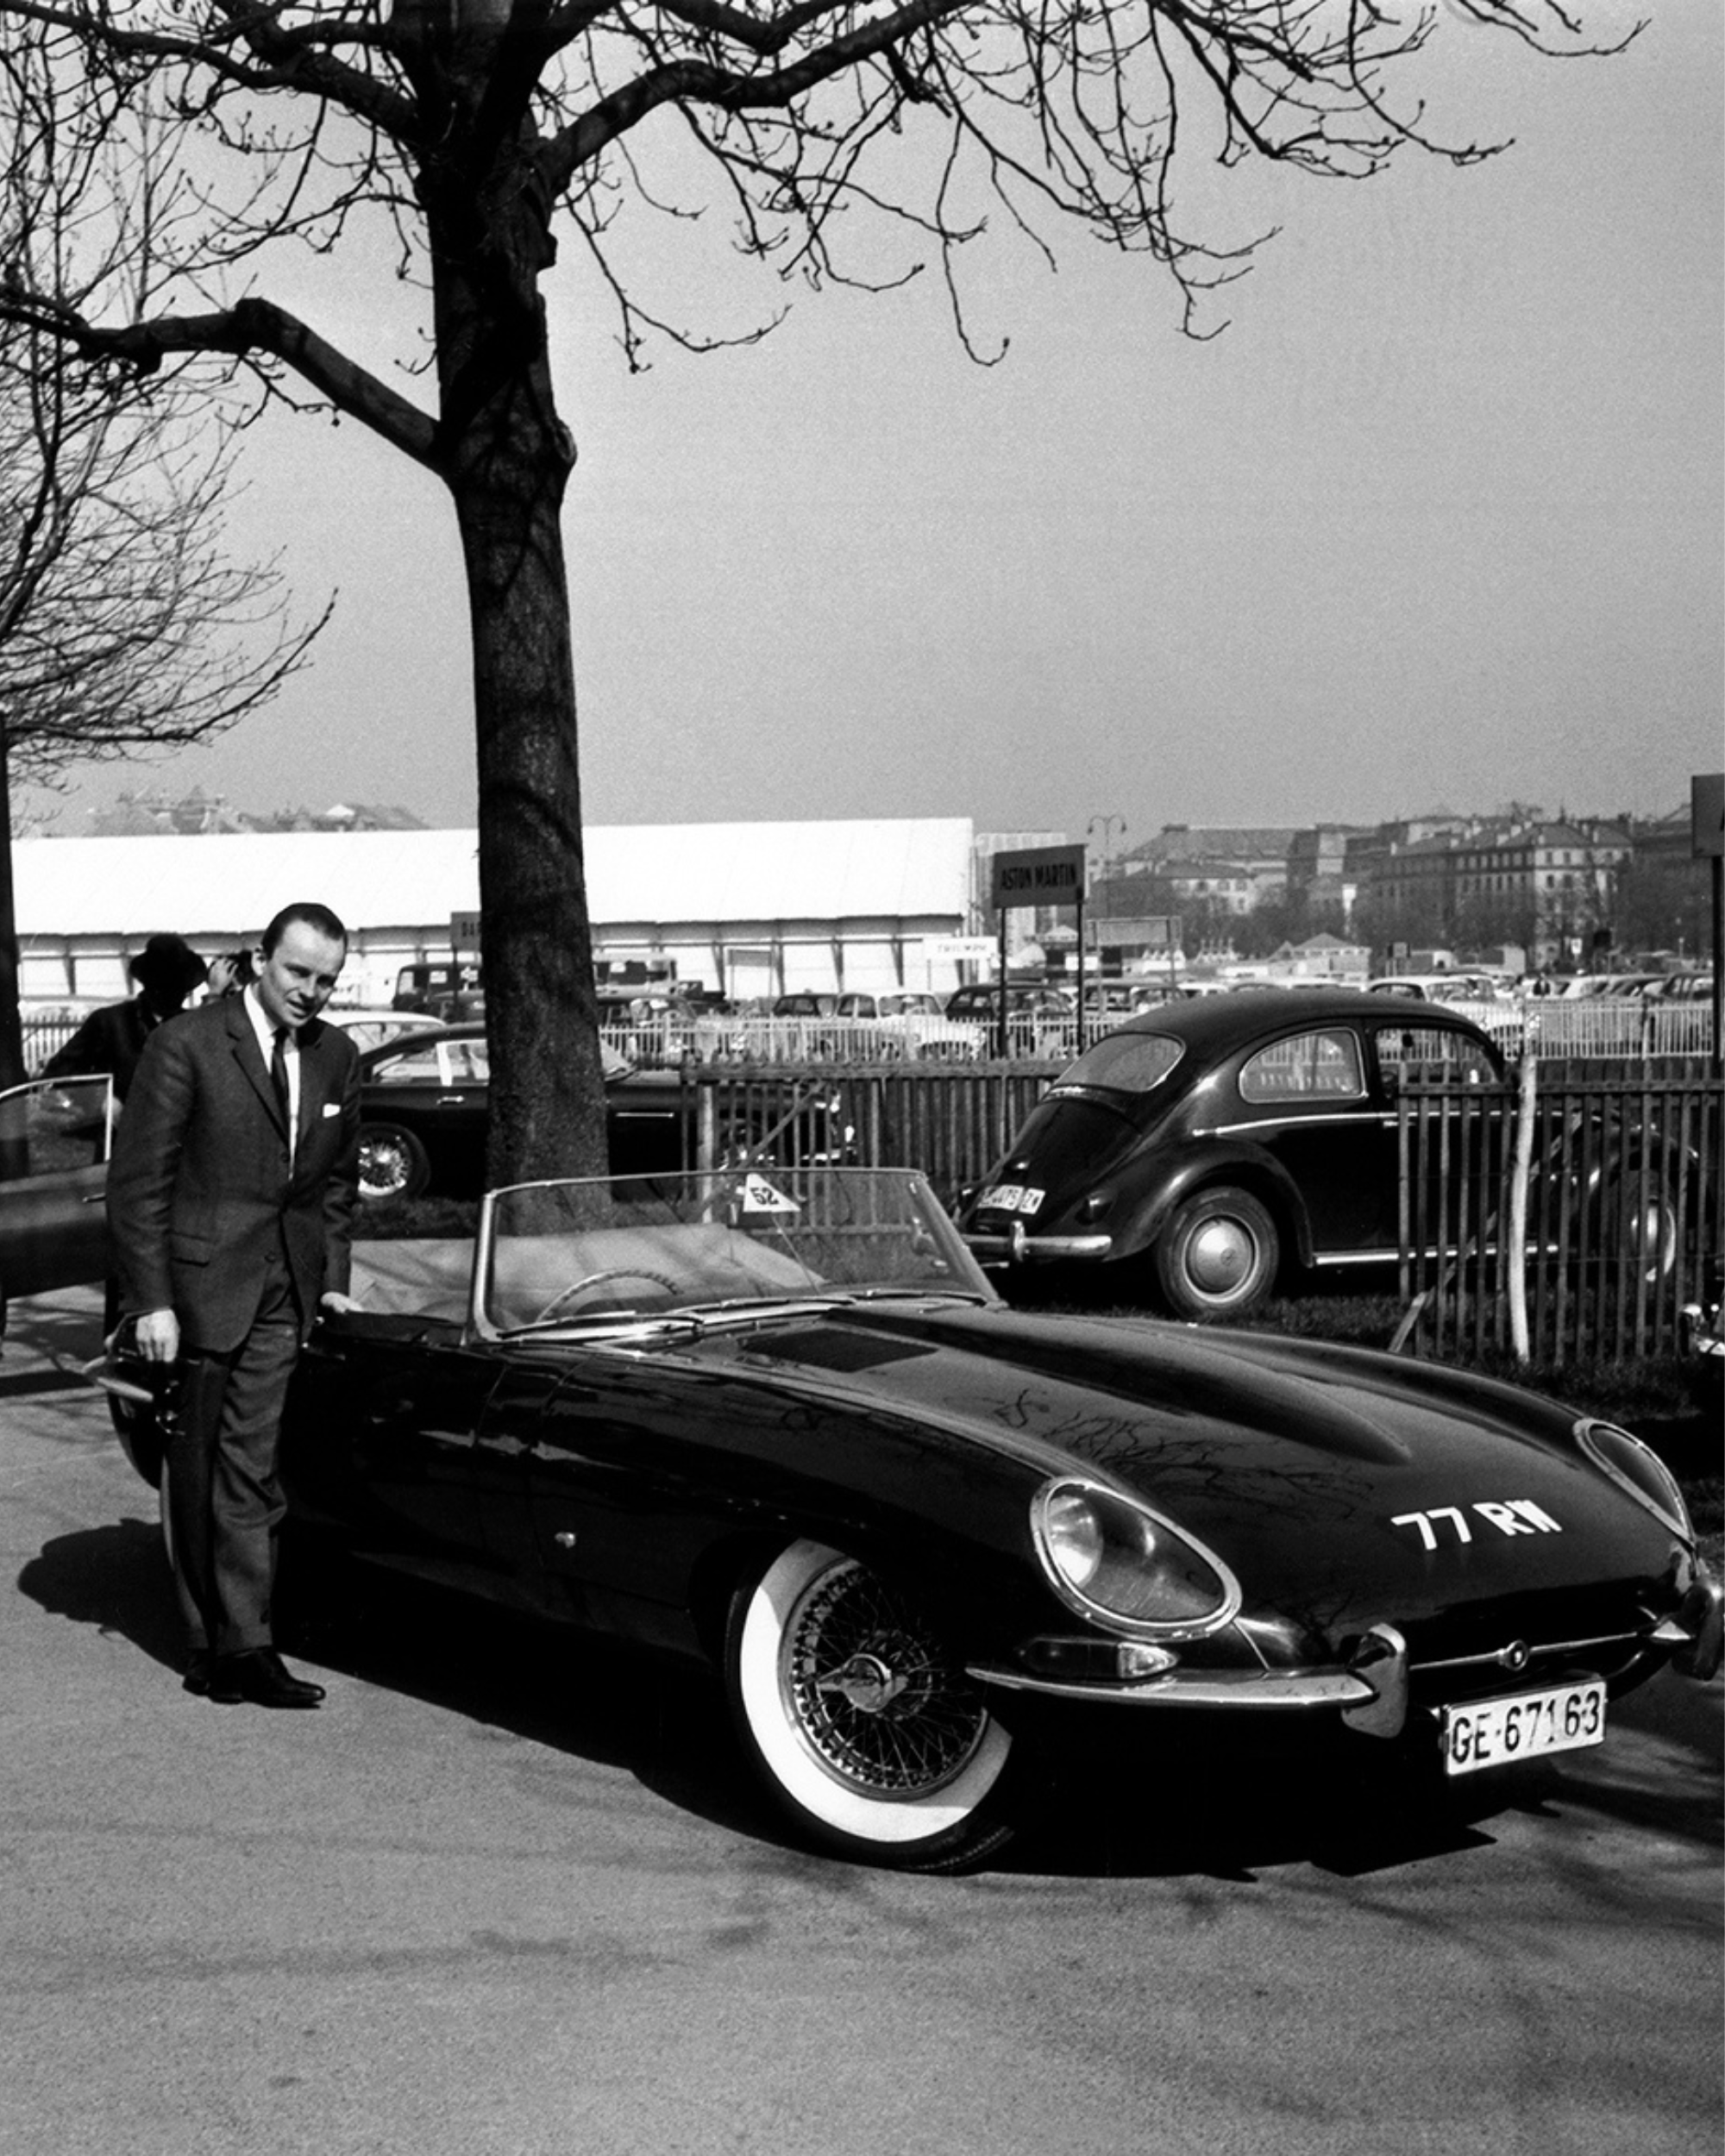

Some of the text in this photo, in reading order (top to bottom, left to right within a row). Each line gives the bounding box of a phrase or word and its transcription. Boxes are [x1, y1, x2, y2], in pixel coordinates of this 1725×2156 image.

[1000, 863, 1076, 890] ASTON MARTIN
[750, 1187, 781, 1205] 52
[1390, 1507, 1472, 1551] 77
